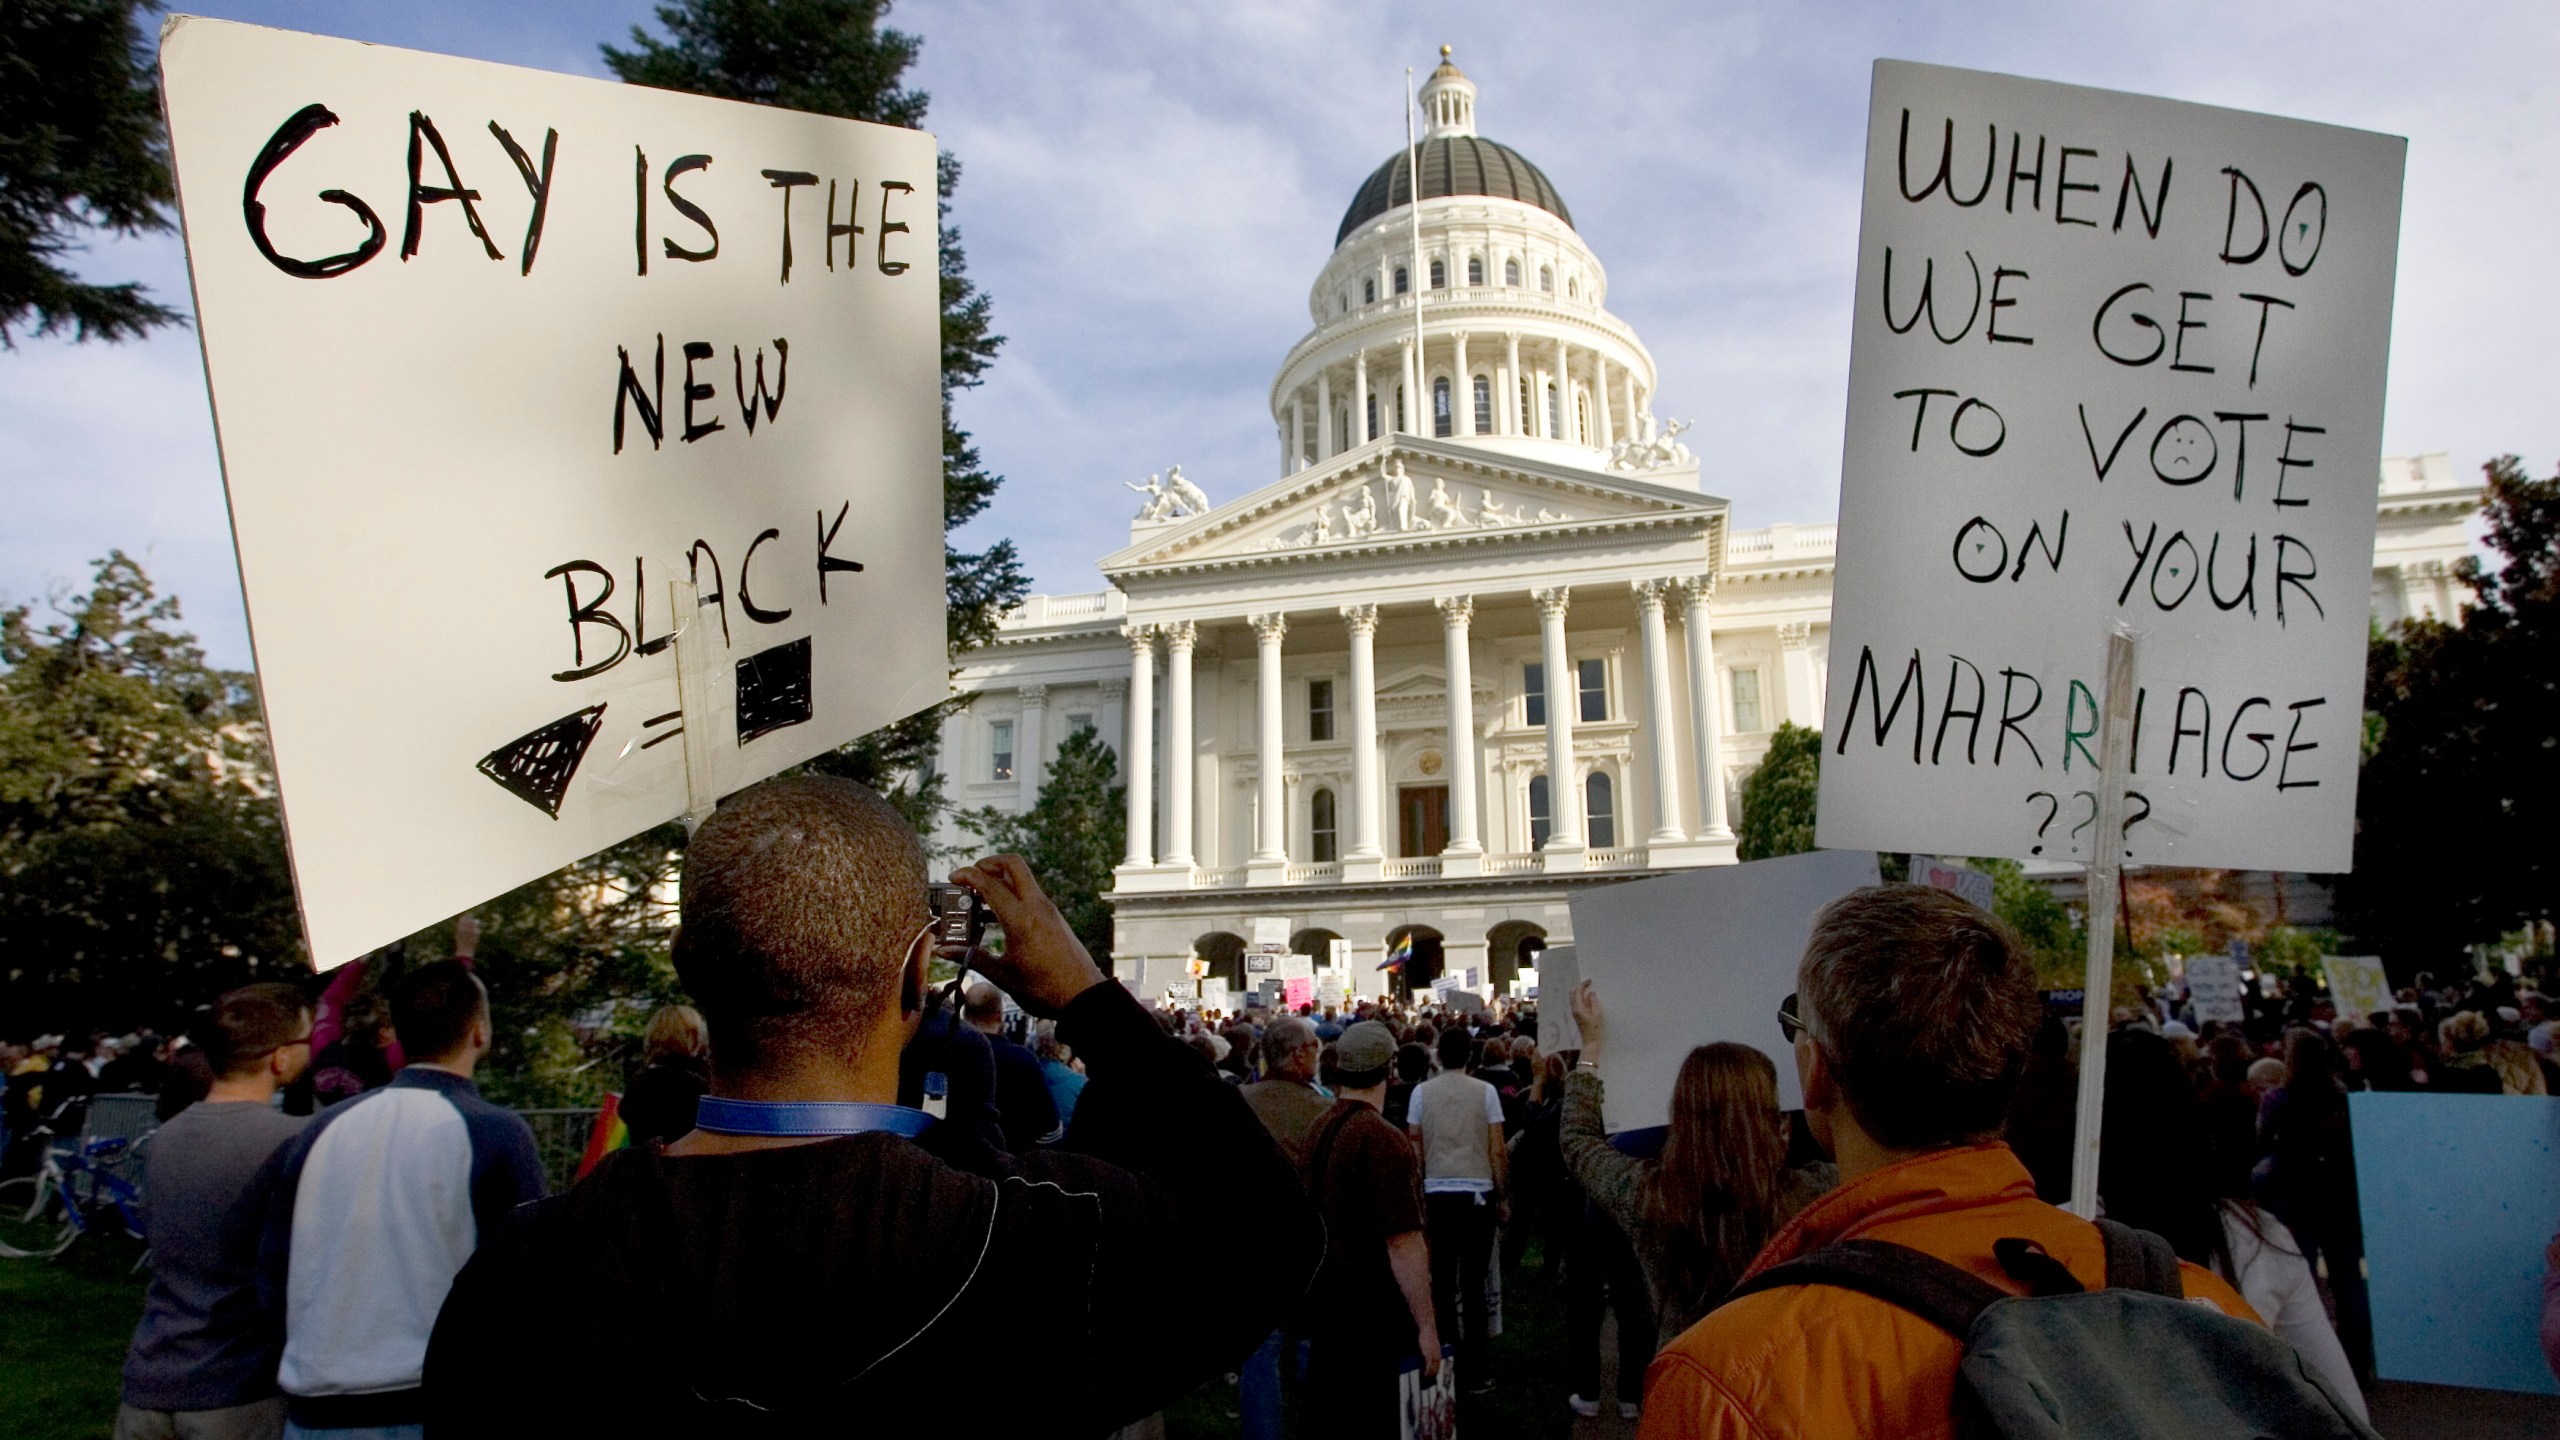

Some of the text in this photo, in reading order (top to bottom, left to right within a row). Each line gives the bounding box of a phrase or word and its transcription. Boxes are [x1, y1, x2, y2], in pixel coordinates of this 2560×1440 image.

[243, 104, 914, 285] GAY IS THE
[1899, 108, 2327, 277] WHEN DO
[1883, 246, 2295, 389] WE GET
[614, 333, 788, 455] NEW
[1893, 388, 2327, 512] TO VOTE
[545, 501, 863, 681] BLACK
[1953, 510, 2324, 628] ON YOUR
[1837, 645, 2326, 791] MARRIAGE
[2026, 791, 2150, 856] ???
